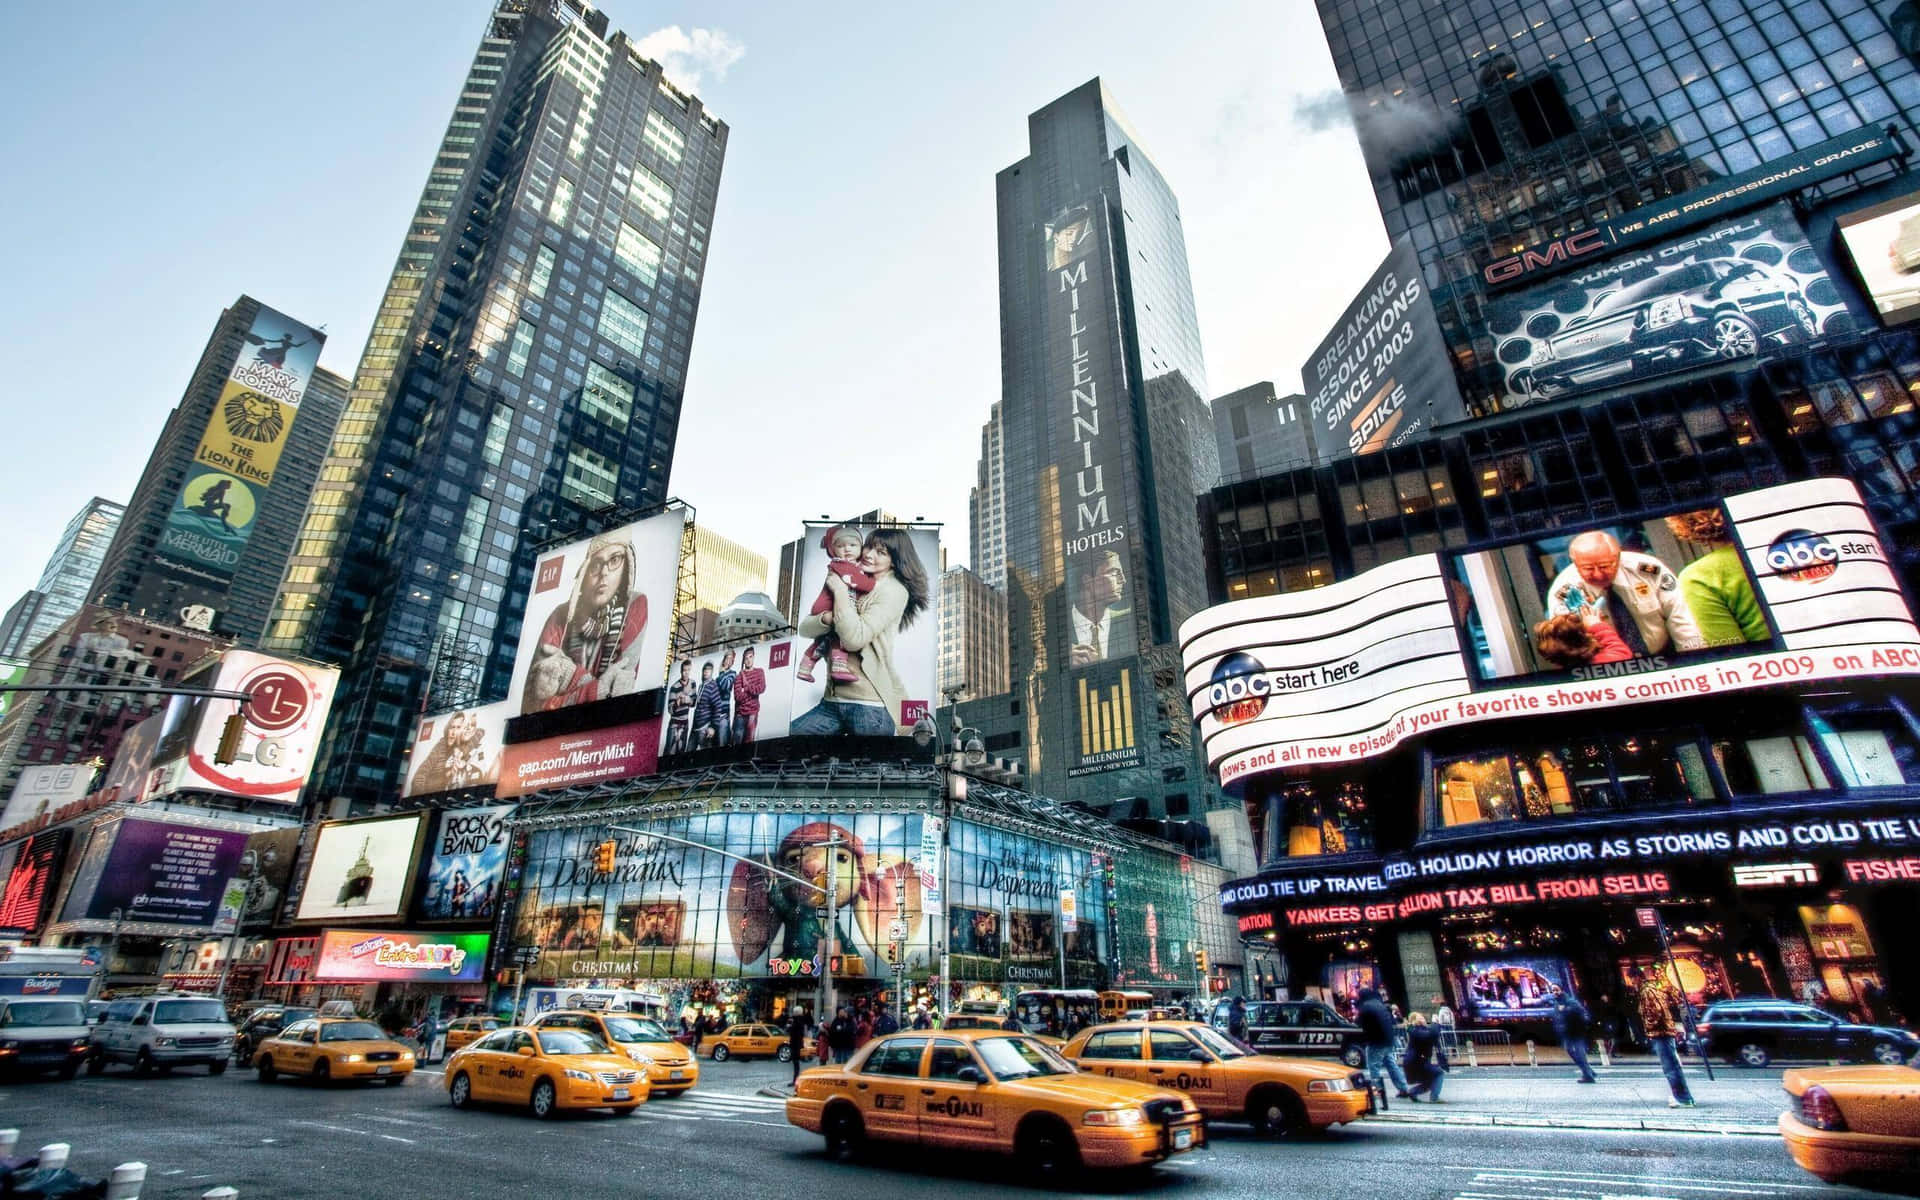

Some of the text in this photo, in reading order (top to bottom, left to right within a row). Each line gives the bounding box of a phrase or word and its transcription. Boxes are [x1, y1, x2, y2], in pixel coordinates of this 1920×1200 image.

[1619, 220, 1644, 235] WE
[1648, 208, 1679, 226] ARE
[1683, 166, 1811, 214] PROFESSIONAL
[1484, 227, 1601, 284] GMC
[1572, 218, 1762, 285] YUKON DENALI
[1316, 272, 1398, 380] BREAKING
[1310, 278, 1420, 420] RESOLUTIONS
[232, 366, 302, 405] POPPINS
[250, 361, 298, 388] MARY
[1326, 320, 1414, 430] SINCE 2003
[1060, 260, 1110, 532] MILLENNIUM
[1349, 384, 1407, 454] SPIKE
[1392, 418, 1421, 448] ACTION
[198, 444, 270, 482] LION KING
[230, 442, 255, 460] THE
[162, 528, 239, 566] MERMAID
[1066, 526, 1126, 556] HOTELS
[1766, 542, 1837, 570] abc
[542, 566, 558, 583] GAP
[774, 650, 786, 662] GAP
[1571, 656, 1668, 682] SIEMENS
[1210, 660, 1360, 706] abc start here
[1250, 750, 1276, 768] and
[1282, 745, 1301, 762] all
[1307, 746, 1342, 758] new
[1396, 716, 1406, 735] of
[1410, 708, 1450, 733] your
[1458, 693, 1539, 718] favorite
[1547, 686, 1617, 706] shows
[1625, 674, 1712, 700] coming
[1718, 666, 1741, 686] in
[1748, 655, 1814, 681] 2009
[1832, 655, 1864, 670] on
[560, 739, 593, 750] Experience
[1082, 748, 1137, 766] MILLENNIUM
[518, 742, 635, 776] gap.com/MerryMixIt
[1069, 760, 1139, 777] BROADWAY NEW YORK
[526, 778, 549, 786] surprise
[595, 768, 607, 776] and
[608, 766, 625, 774] more
[447, 815, 504, 844] ROCK 2
[441, 834, 488, 856] BAND
[615, 837, 644, 858] Tale
[644, 840, 663, 862] of
[1000, 846, 1020, 870] The
[1420, 852, 1501, 874] HOLIDAY
[1507, 842, 1595, 866] HORROR
[1600, 840, 1630, 858] AS
[1636, 830, 1731, 854] STORMS
[1738, 827, 1788, 848] AND
[1792, 823, 1860, 844] COLD
[1862, 821, 1906, 839] TIE
[1733, 862, 1819, 886] ESPN
[1237, 885, 1269, 900] COLD
[1271, 880, 1295, 896] TIE
[1298, 879, 1320, 893] UP
[1324, 876, 1387, 892] TRAVEL
[1287, 905, 1361, 925] YANKEES
[1364, 904, 1396, 921] GET
[1446, 887, 1488, 907] TAX
[1489, 884, 1536, 902] BILL
[1537, 878, 1599, 900] FROM
[1604, 873, 1669, 896] SELIG
[572, 960, 639, 974] CHRISTMAS
[769, 958, 812, 975] Toys
[1008, 966, 1053, 978] CHRISTMAS
[24, 978, 62, 990] Budget
[1298, 1032, 1334, 1043] NYPD
[1177, 1072, 1212, 1089] TAXI
[946, 1096, 983, 1117] TAXI
